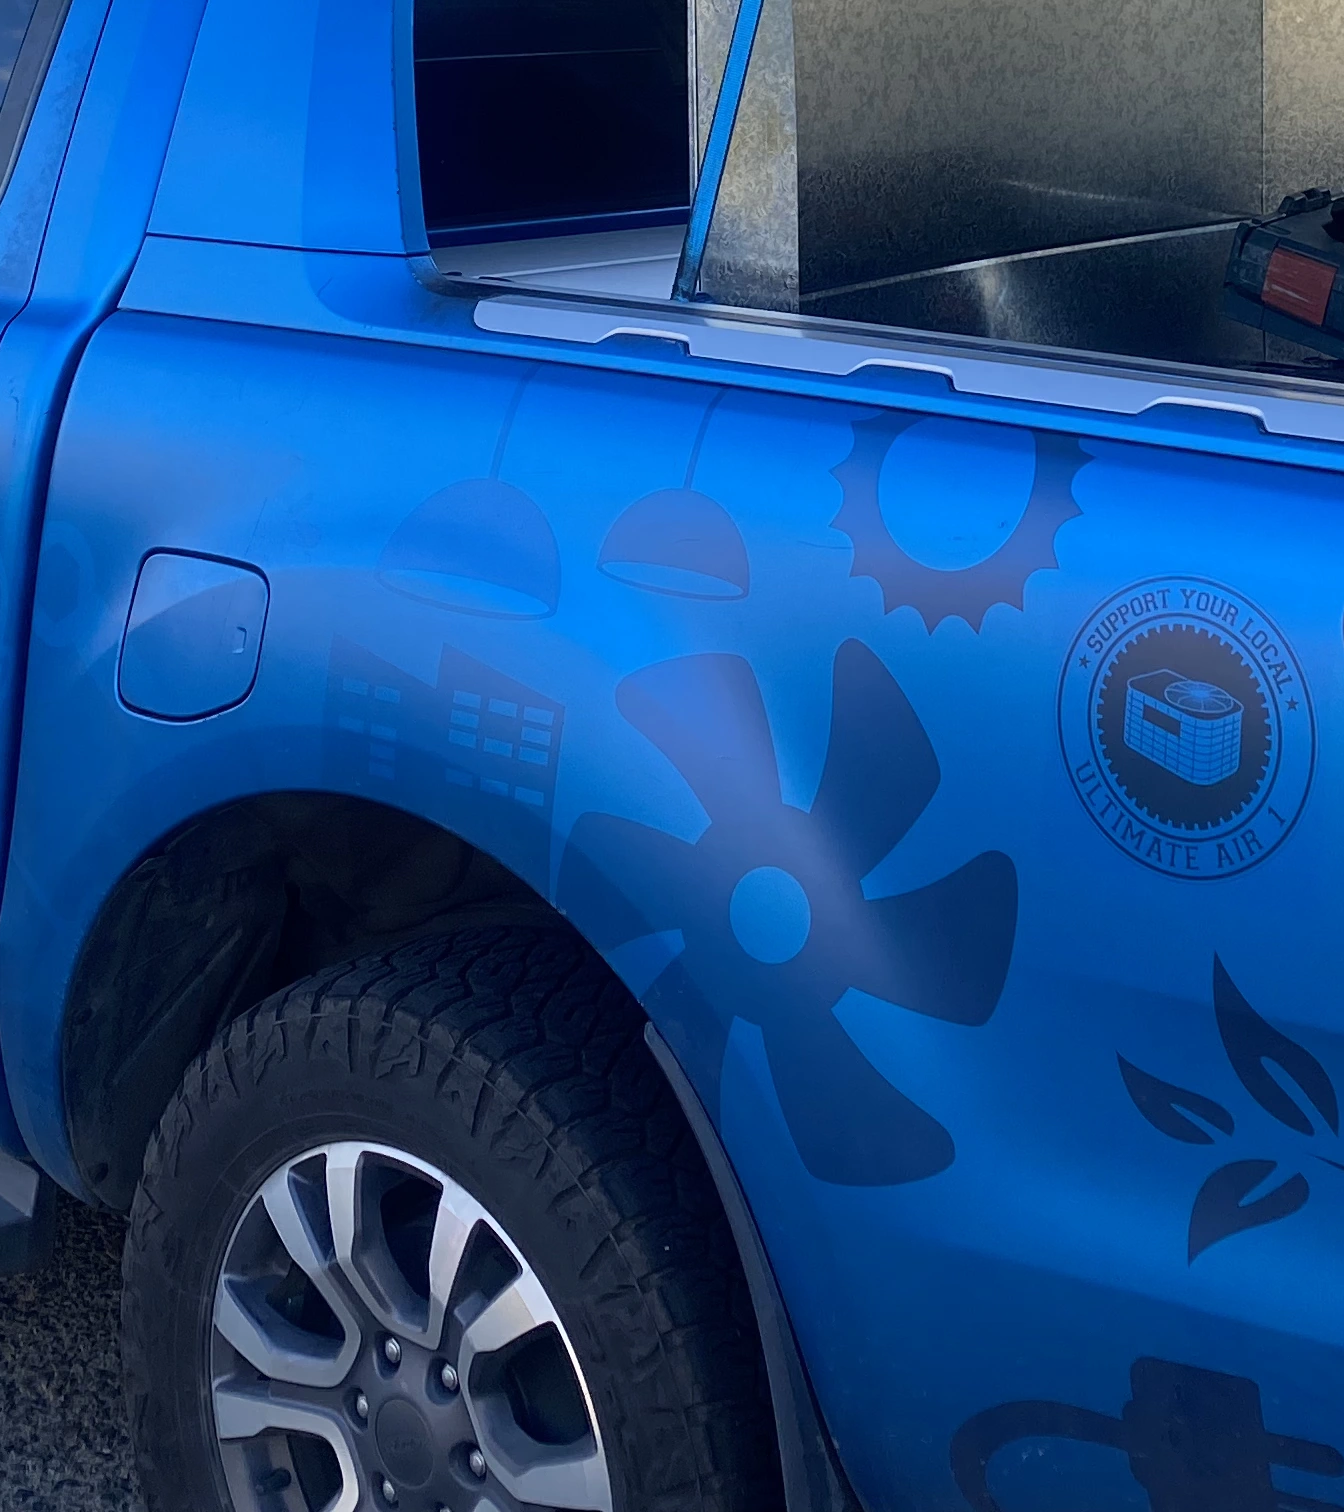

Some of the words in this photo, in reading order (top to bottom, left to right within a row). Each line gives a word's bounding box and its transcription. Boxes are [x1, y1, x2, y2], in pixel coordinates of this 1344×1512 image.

[1086, 587, 1171, 654] SUPPORT
[1179, 587, 1240, 627] YOUR
[1238, 617, 1293, 694] LOCAL
[1075, 759, 1200, 871] ULTIMATE
[1215, 828, 1265, 869] AIR
[1267, 804, 1287, 827] 1
